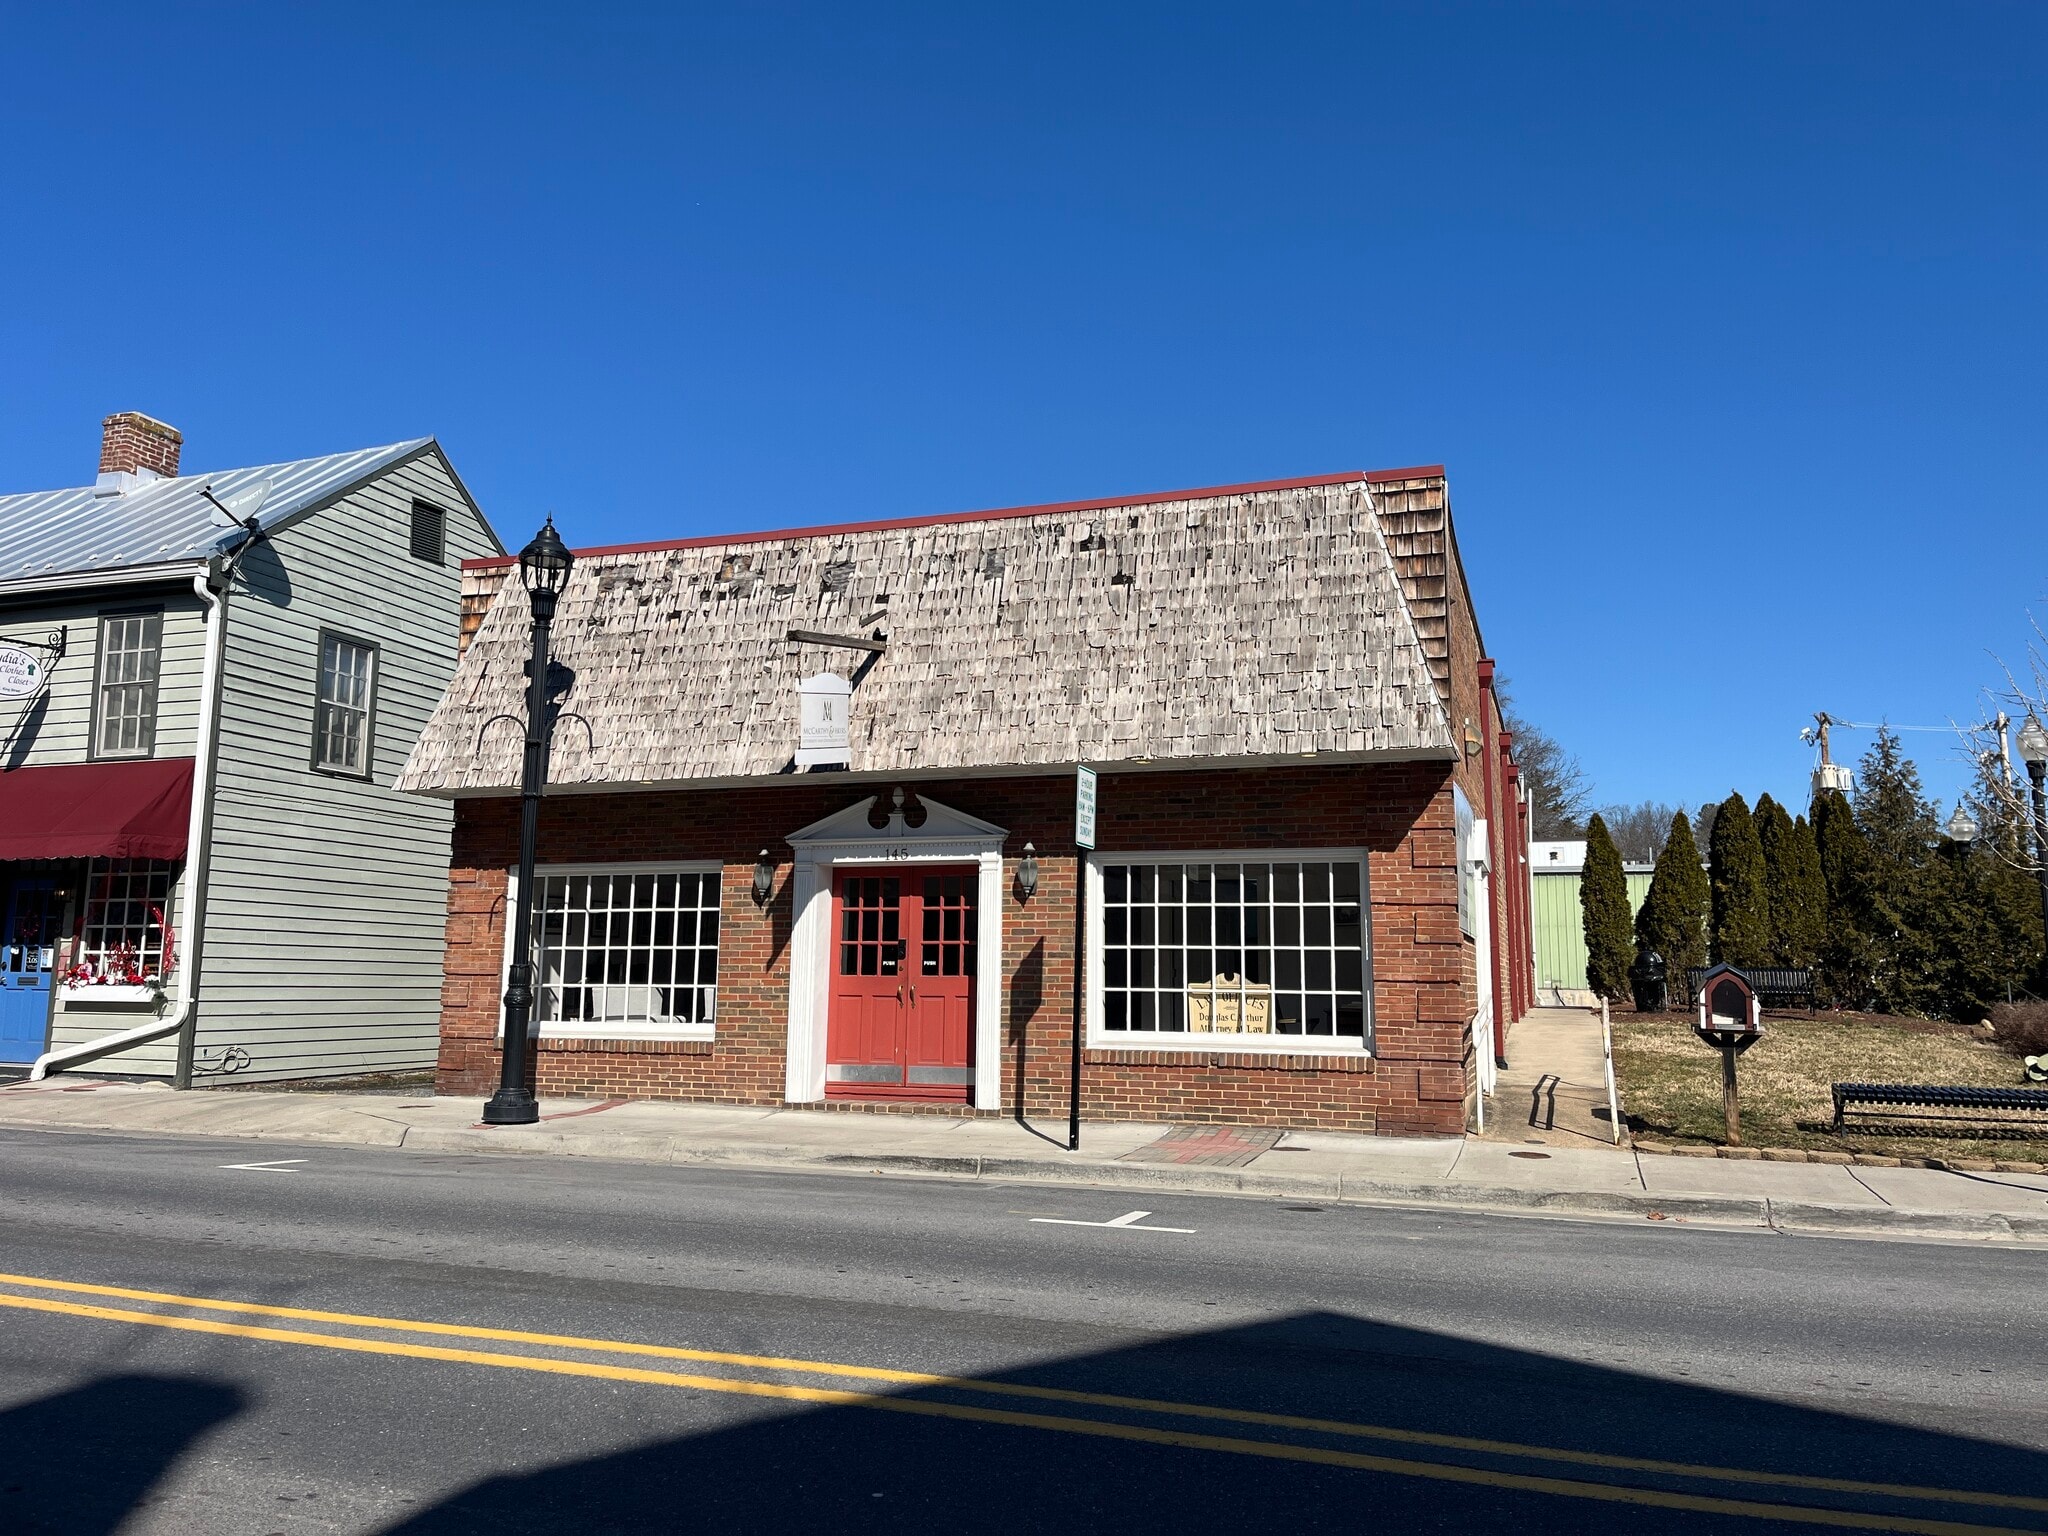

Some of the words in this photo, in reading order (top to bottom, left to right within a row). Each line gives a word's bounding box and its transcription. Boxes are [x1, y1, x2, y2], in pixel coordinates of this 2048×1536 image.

[239, 487, 263, 505] DIRECTV
[0, 665, 25, 676] Clothes
[8, 676, 28, 685] Closet
[1080, 789, 1093, 803] PARKING
[1081, 814, 1091, 825] EXCEPT
[1080, 826, 1091, 837] SUNDAY
[885, 848, 909, 861] 145
[1221, 991, 1265, 1010] OFFCES
[1237, 1013, 1264, 1022] Athur
[1246, 1024, 1264, 1033] Law
